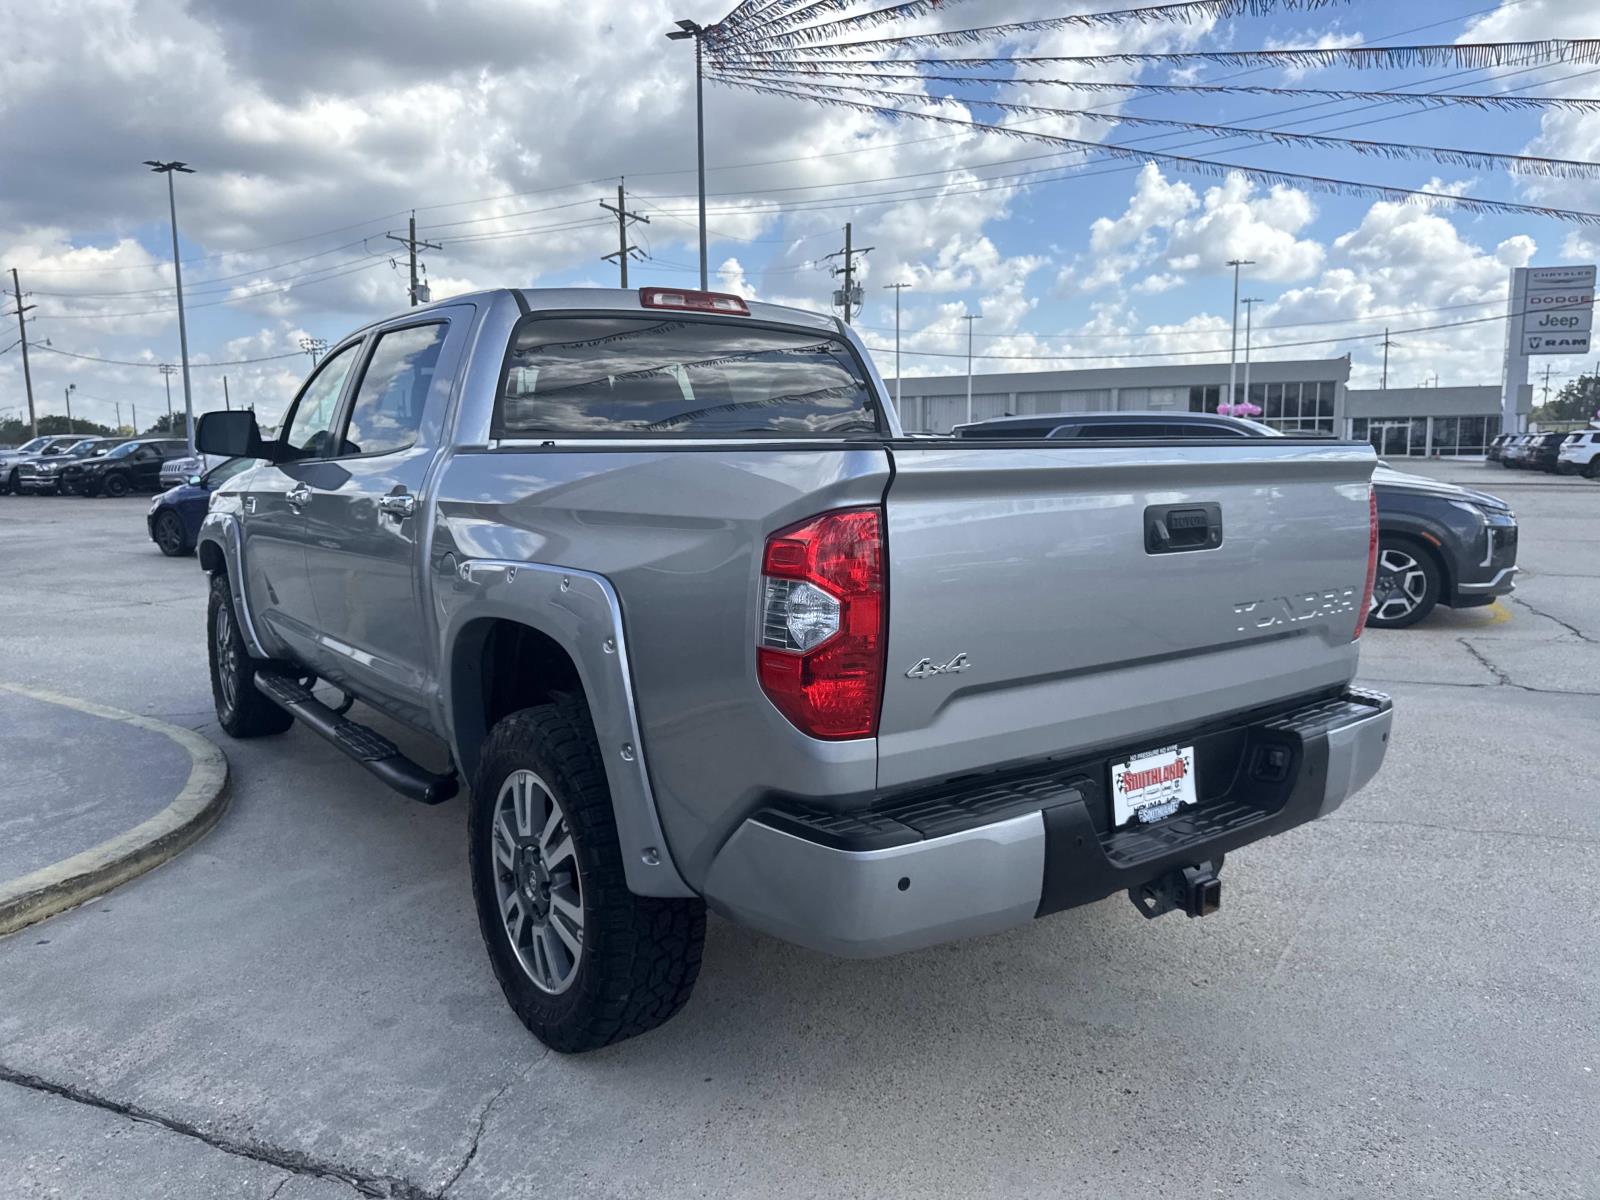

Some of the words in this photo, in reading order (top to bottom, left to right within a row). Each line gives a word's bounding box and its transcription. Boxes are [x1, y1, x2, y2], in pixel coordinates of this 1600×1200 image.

[1530, 295, 1591, 305] DODGE
[1538, 313, 1579, 328] Jeep
[1545, 338, 1587, 346] RAM
[1233, 585, 1356, 631] TUNDRA
